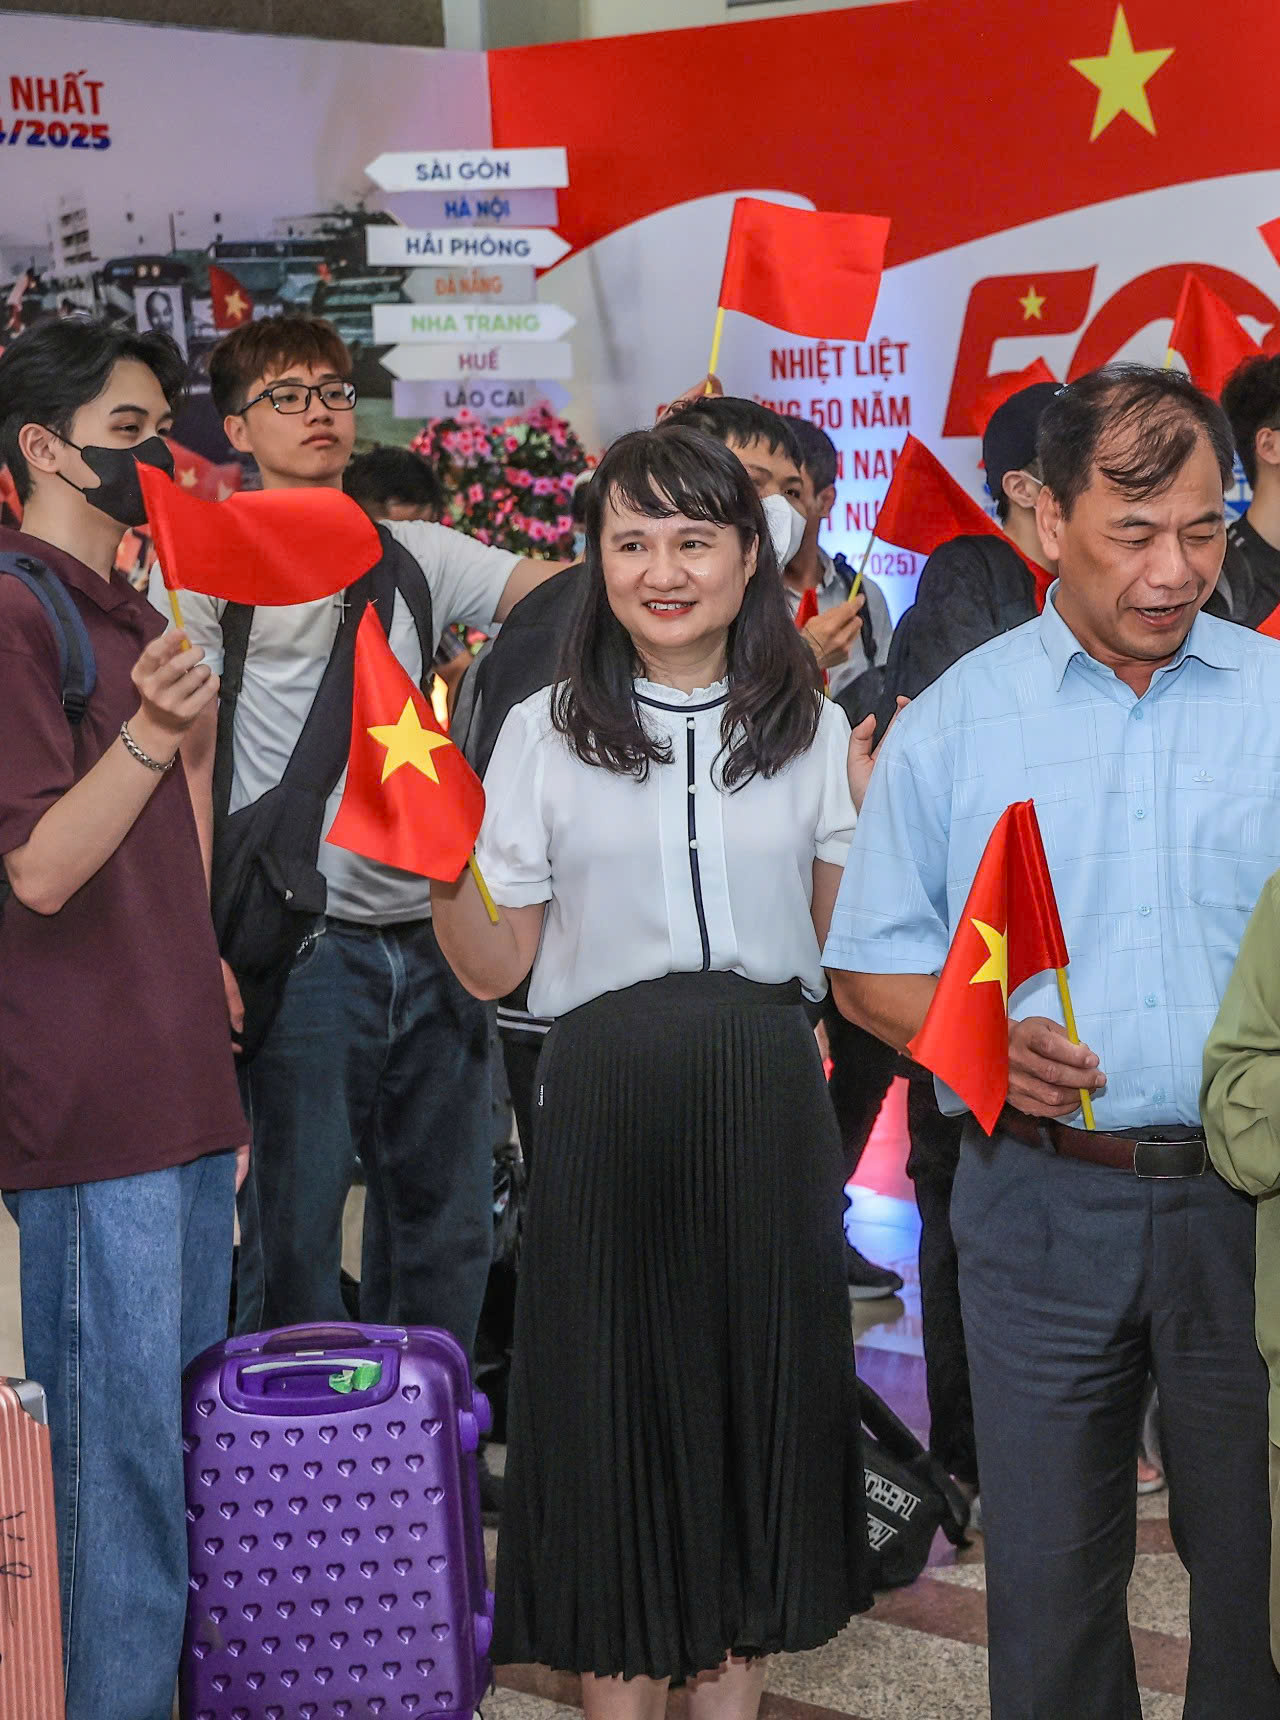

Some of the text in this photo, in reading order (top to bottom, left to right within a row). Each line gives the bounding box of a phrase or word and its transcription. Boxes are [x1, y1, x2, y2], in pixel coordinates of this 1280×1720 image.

[9, 69, 104, 116] NHẤT
[416, 155, 510, 182] SÀI GÒN
[444, 196, 511, 223] HÀ NỘI
[450, 233, 532, 257] PHÒNG
[411, 314, 541, 333] NHA TRANG
[458, 346, 501, 371] HUẾ
[770, 337, 910, 384] NHIỆT LIỆT
[445, 384, 526, 408] LÀO CAI
[810, 397, 843, 430] 50
[852, 391, 911, 430] NĂM
